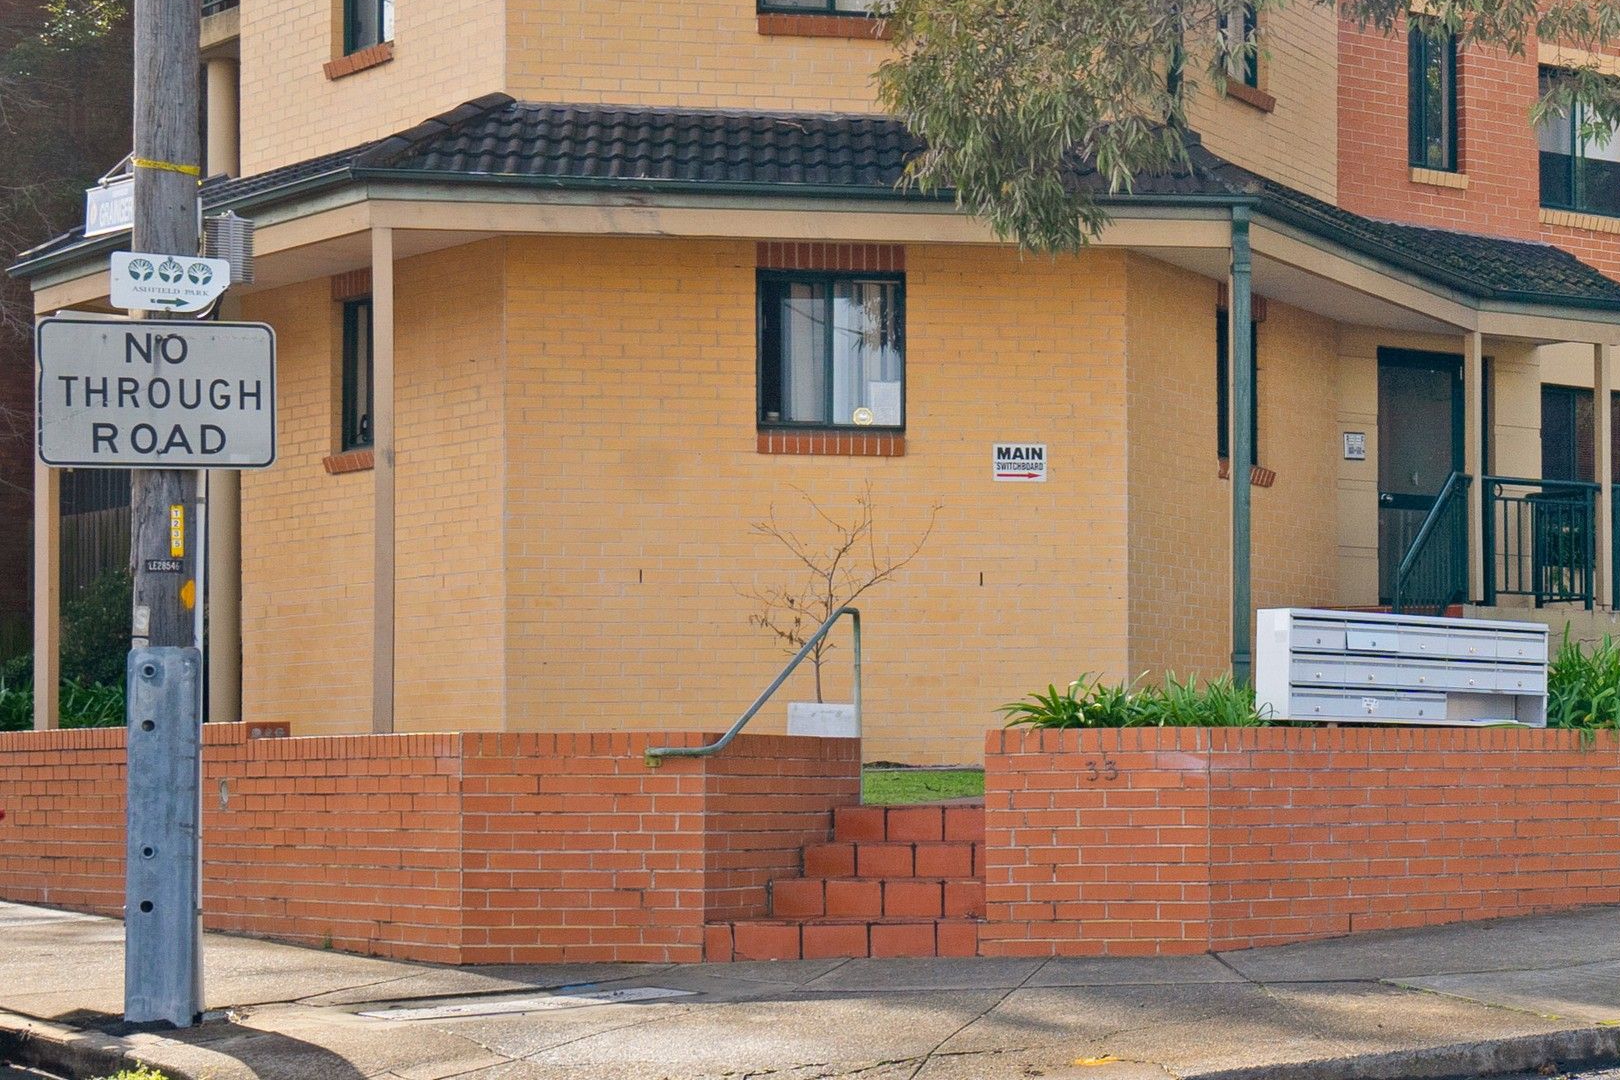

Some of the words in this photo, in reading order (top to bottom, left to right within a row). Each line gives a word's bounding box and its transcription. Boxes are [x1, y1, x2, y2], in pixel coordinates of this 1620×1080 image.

[132, 286, 181, 295] ASHFIELD
[184, 289, 210, 297] PARK
[125, 332, 188, 365] NO
[58, 375, 262, 411] THROUGH
[92, 422, 227, 455] ROAD
[996, 447, 1043, 460] MAIN
[996, 462, 1044, 471] SWITCHBOARD
[1085, 759, 1119, 782] 33
